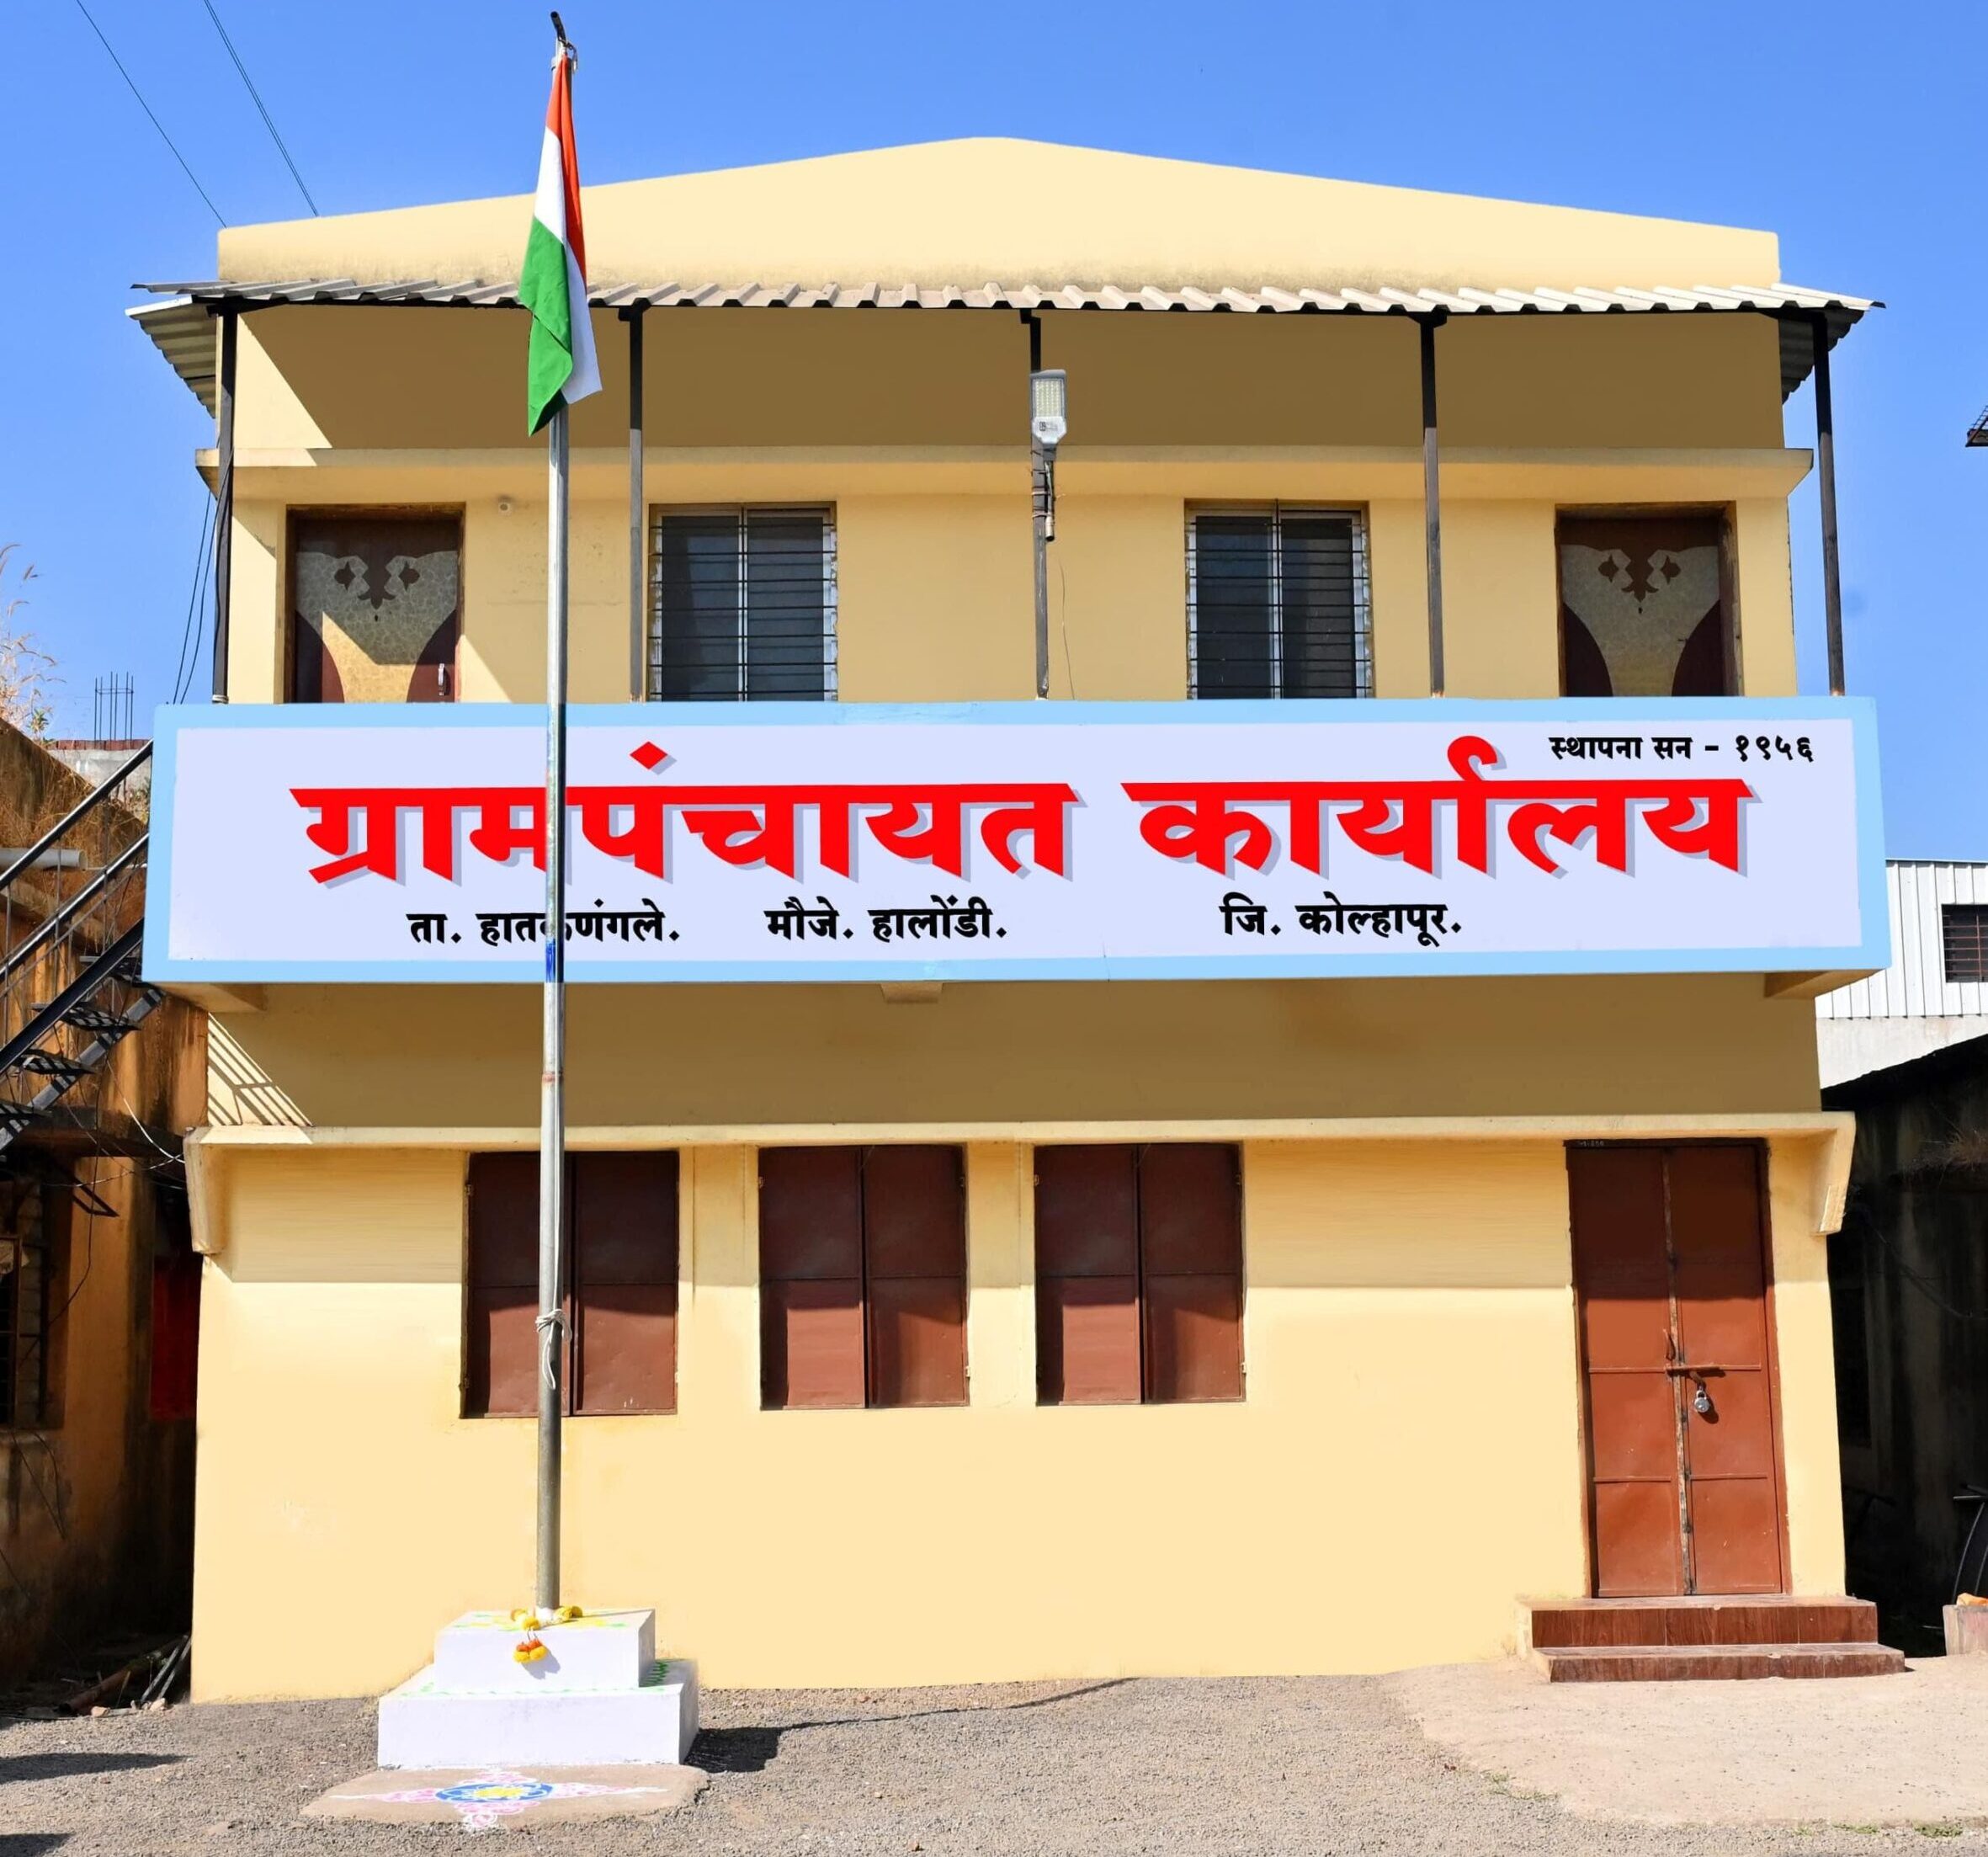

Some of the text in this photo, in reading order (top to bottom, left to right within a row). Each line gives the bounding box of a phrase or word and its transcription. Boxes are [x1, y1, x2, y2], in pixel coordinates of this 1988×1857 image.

[1548, 736, 1644, 761] स्थापना
[1650, 736, 1693, 761] सन
[1736, 734, 1815, 763] १९५६
[290, 735, 1754, 884] ग्रामपंचायत कार्यालय
[406, 913, 461, 944] ता.
[763, 896, 853, 940] मौजे.
[867, 894, 1007, 943] हालोंडी.
[1218, 891, 1281, 935] जि.
[1294, 891, 1462, 948] कोल्हापूर.
